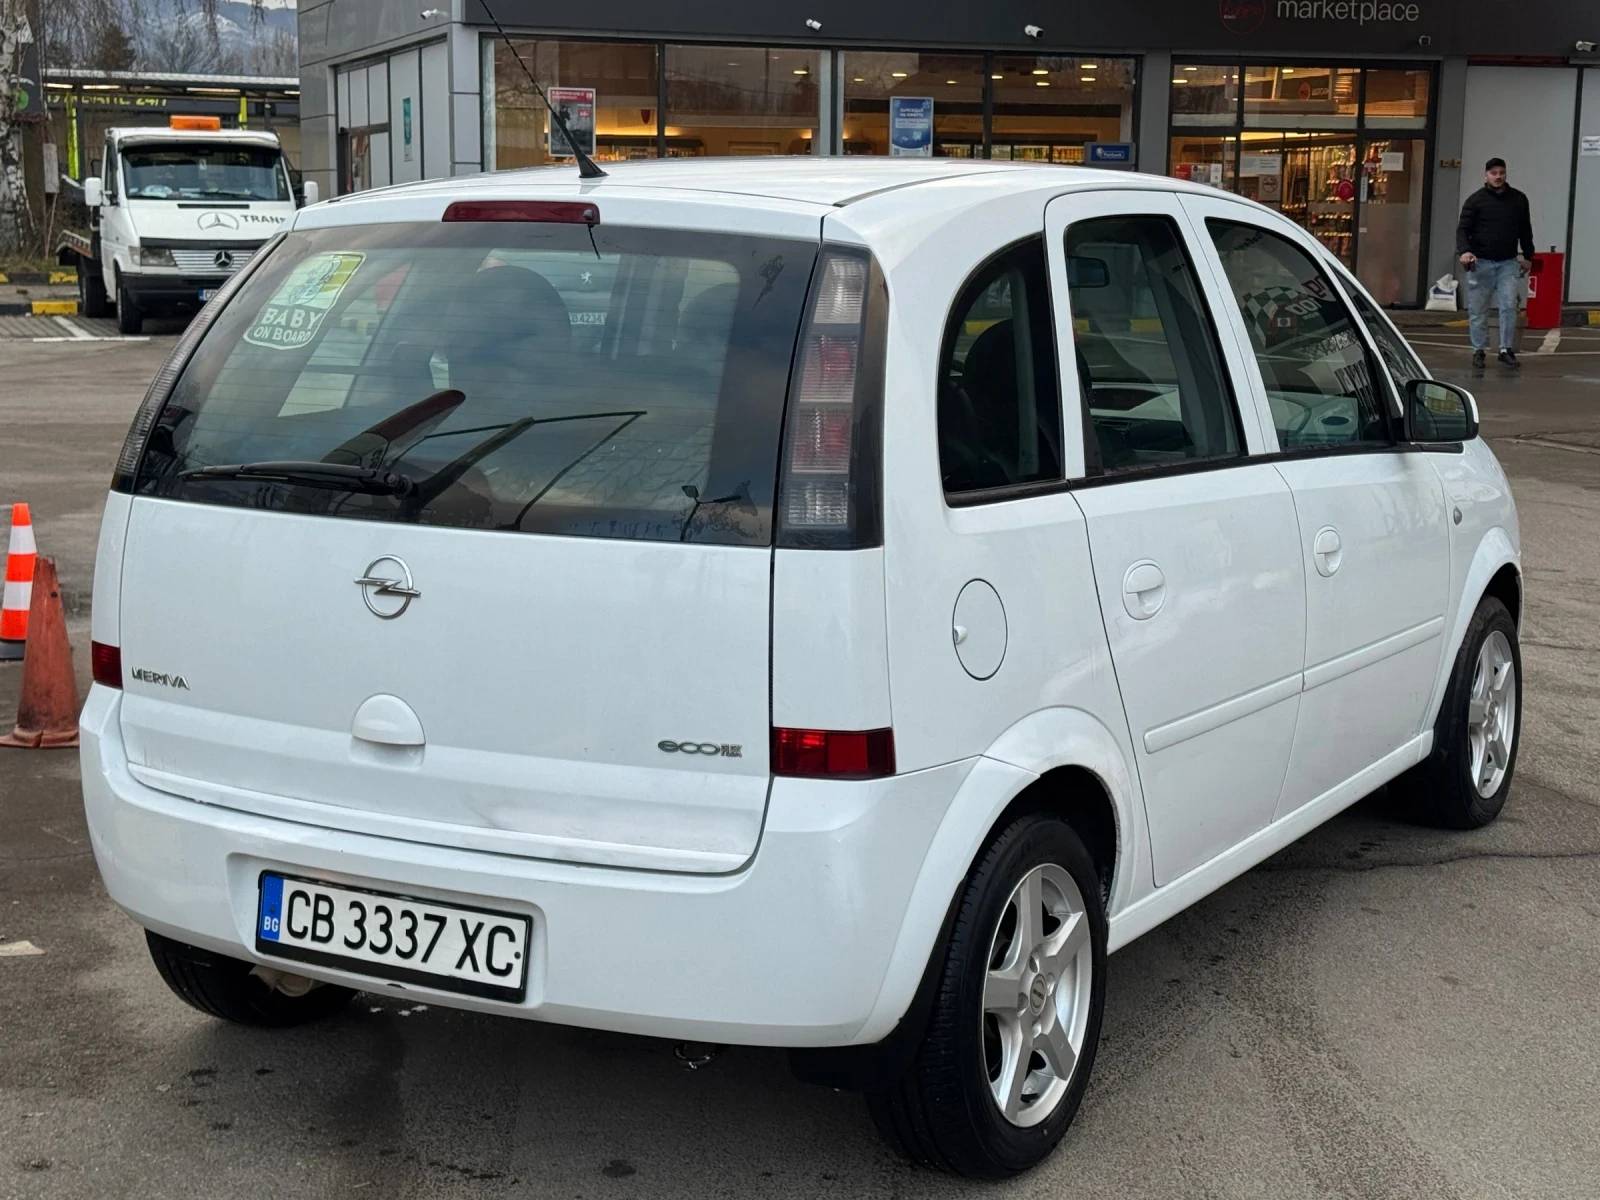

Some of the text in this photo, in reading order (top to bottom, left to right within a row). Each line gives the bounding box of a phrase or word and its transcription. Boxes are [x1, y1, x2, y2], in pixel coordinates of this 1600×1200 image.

[1276, 0, 1420, 26] marketplace
[260, 307, 324, 330] BABY
[253, 325, 312, 343] ON BOARD
[263, 916, 279, 933] BG
[286, 890, 517, 977] CB 3337 XC
